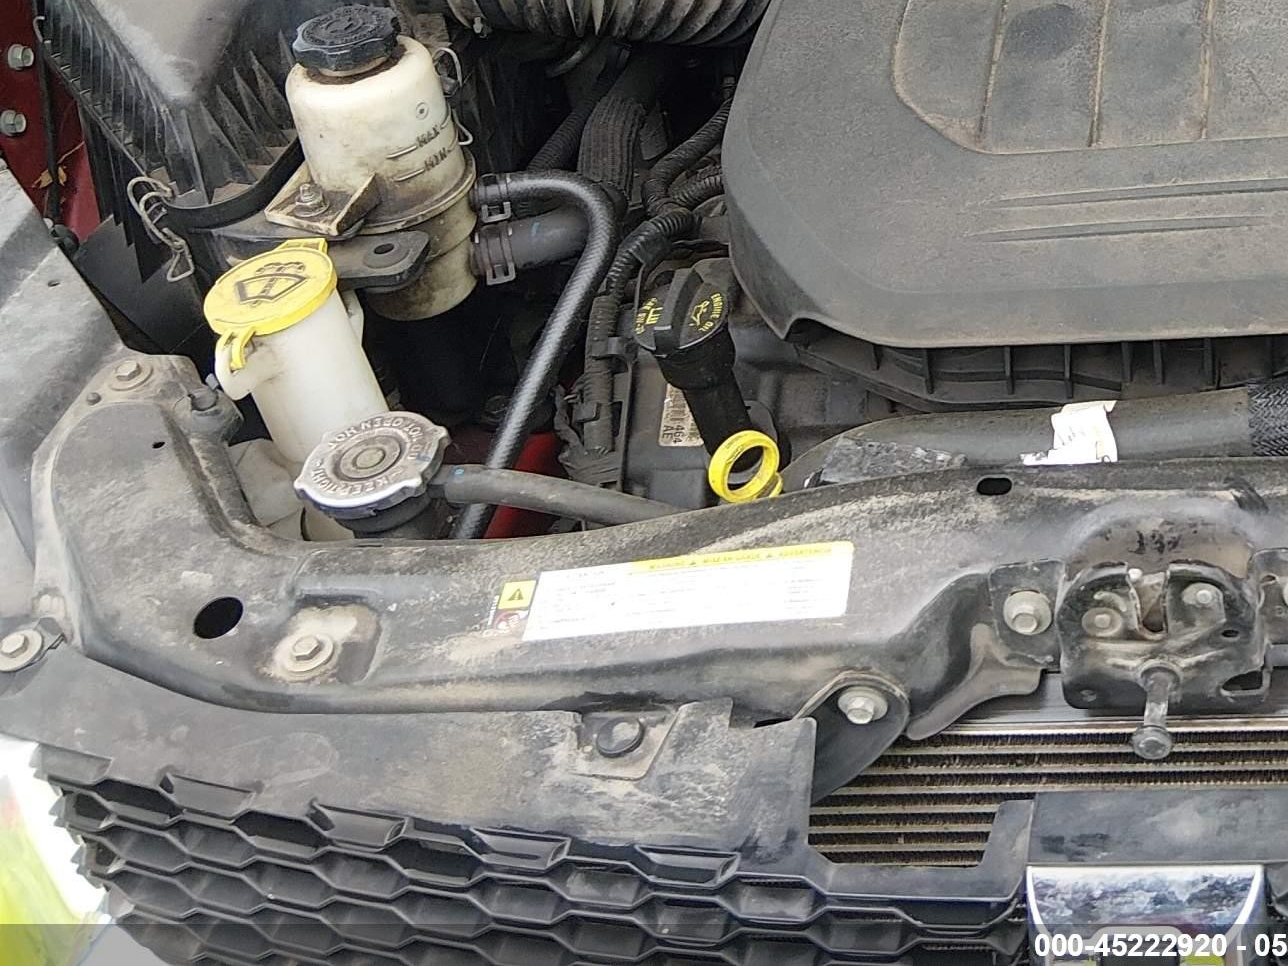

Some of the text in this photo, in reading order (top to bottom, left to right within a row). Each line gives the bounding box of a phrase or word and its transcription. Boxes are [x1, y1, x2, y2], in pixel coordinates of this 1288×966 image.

[361, 417, 404, 430] OPEN
[328, 425, 358, 450] HOT
[311, 467, 389, 496] KEEP TIGHT
